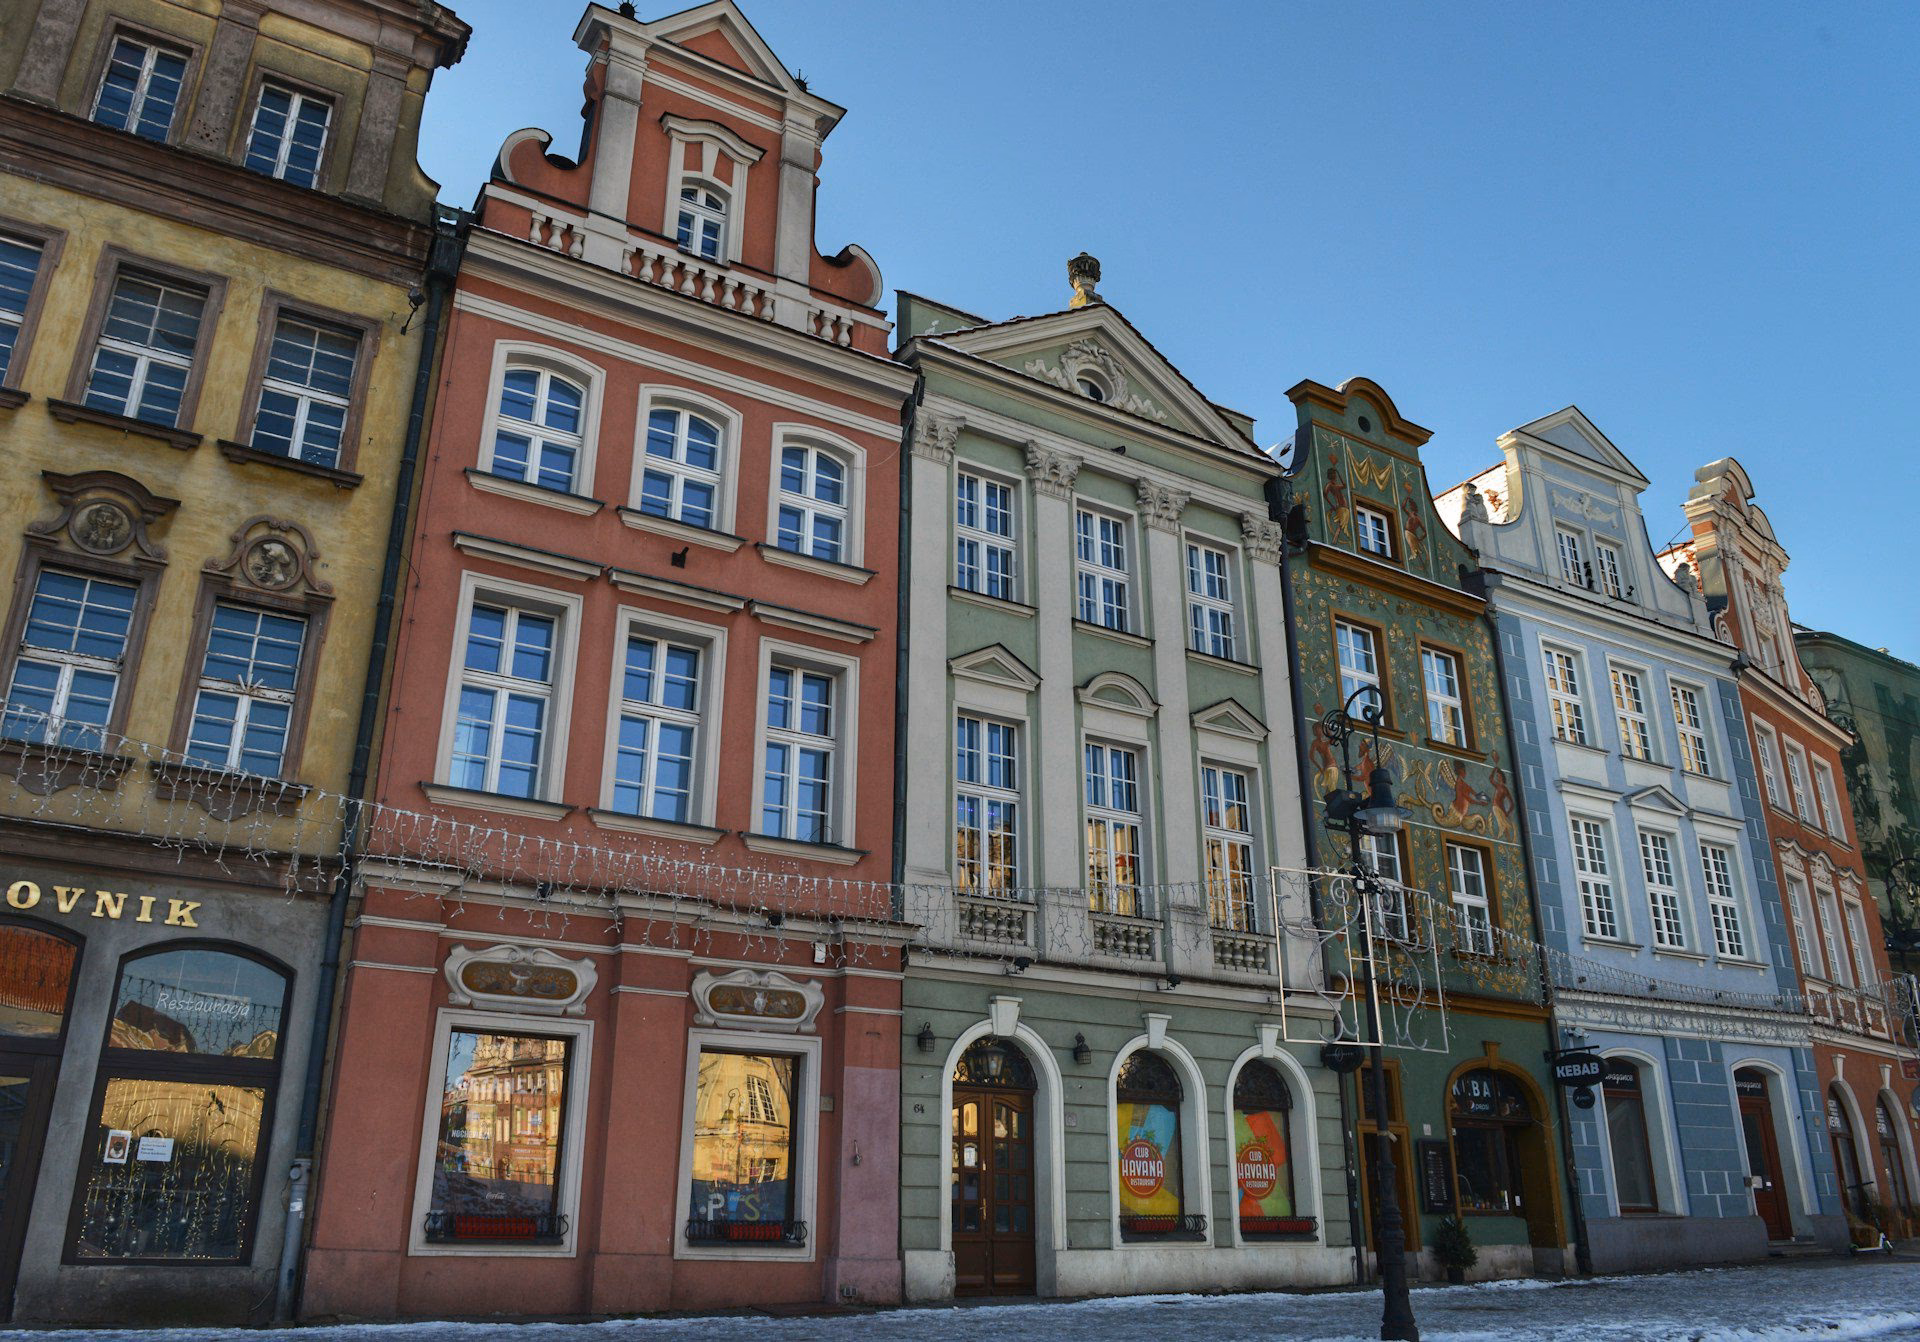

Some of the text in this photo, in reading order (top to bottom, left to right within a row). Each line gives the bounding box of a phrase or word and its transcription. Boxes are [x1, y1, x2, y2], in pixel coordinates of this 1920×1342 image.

[6, 880, 201, 928] OVNIK
[156, 992, 250, 1019] Restauracja
[1556, 1062, 1600, 1078] KEBAB
[913, 1104, 925, 1114] 64
[1134, 1147, 1149, 1158] CLUB
[1249, 1151, 1262, 1162] CLUB
[1121, 1159, 1164, 1178] HAVANA
[1237, 1163, 1276, 1180] HAVANA
